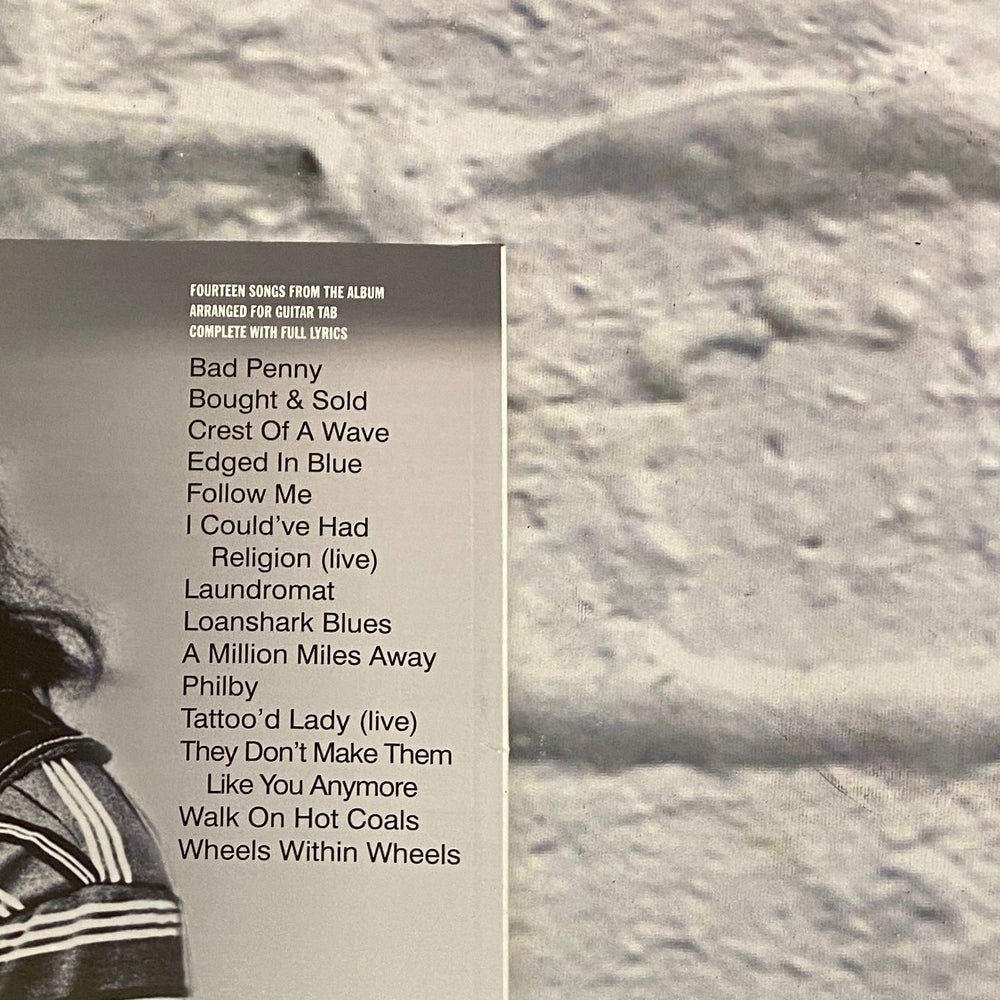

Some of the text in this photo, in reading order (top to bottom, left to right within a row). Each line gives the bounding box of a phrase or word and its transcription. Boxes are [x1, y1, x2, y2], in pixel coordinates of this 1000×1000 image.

[190, 284, 385, 299] FOURTEEN SONGS FROM THE ALBUM
[189, 304, 338, 319] ARRANGED FOR GUITAR TAB
[189, 325, 348, 340] COMPLETE WITH FULL LYRICS
[190, 357, 322, 384] Bad Penny
[189, 389, 367, 414] Bought & Sold
[188, 420, 389, 442] Crest Of A Wave
[188, 451, 362, 476] Edged In Blue
[187, 483, 312, 504] Follow Me
[186, 514, 369, 537] I Could’ve Had
[212, 547, 378, 574] Religion (live)
[185, 579, 335, 600] Laundromat
[184, 611, 392, 634] Loanshark Blues
[182, 643, 437, 672] A Million Miles Away
[182, 675, 258, 701] Philby
[181, 708, 418, 736] Tattoo’d Lady (live)
[181, 740, 452, 766] They Don’t Make Them
[207, 774, 418, 801] Like You Anymore
[179, 806, 419, 830] Walk On Hot Coals
[178, 839, 461, 865] Wheels Within Wheels
